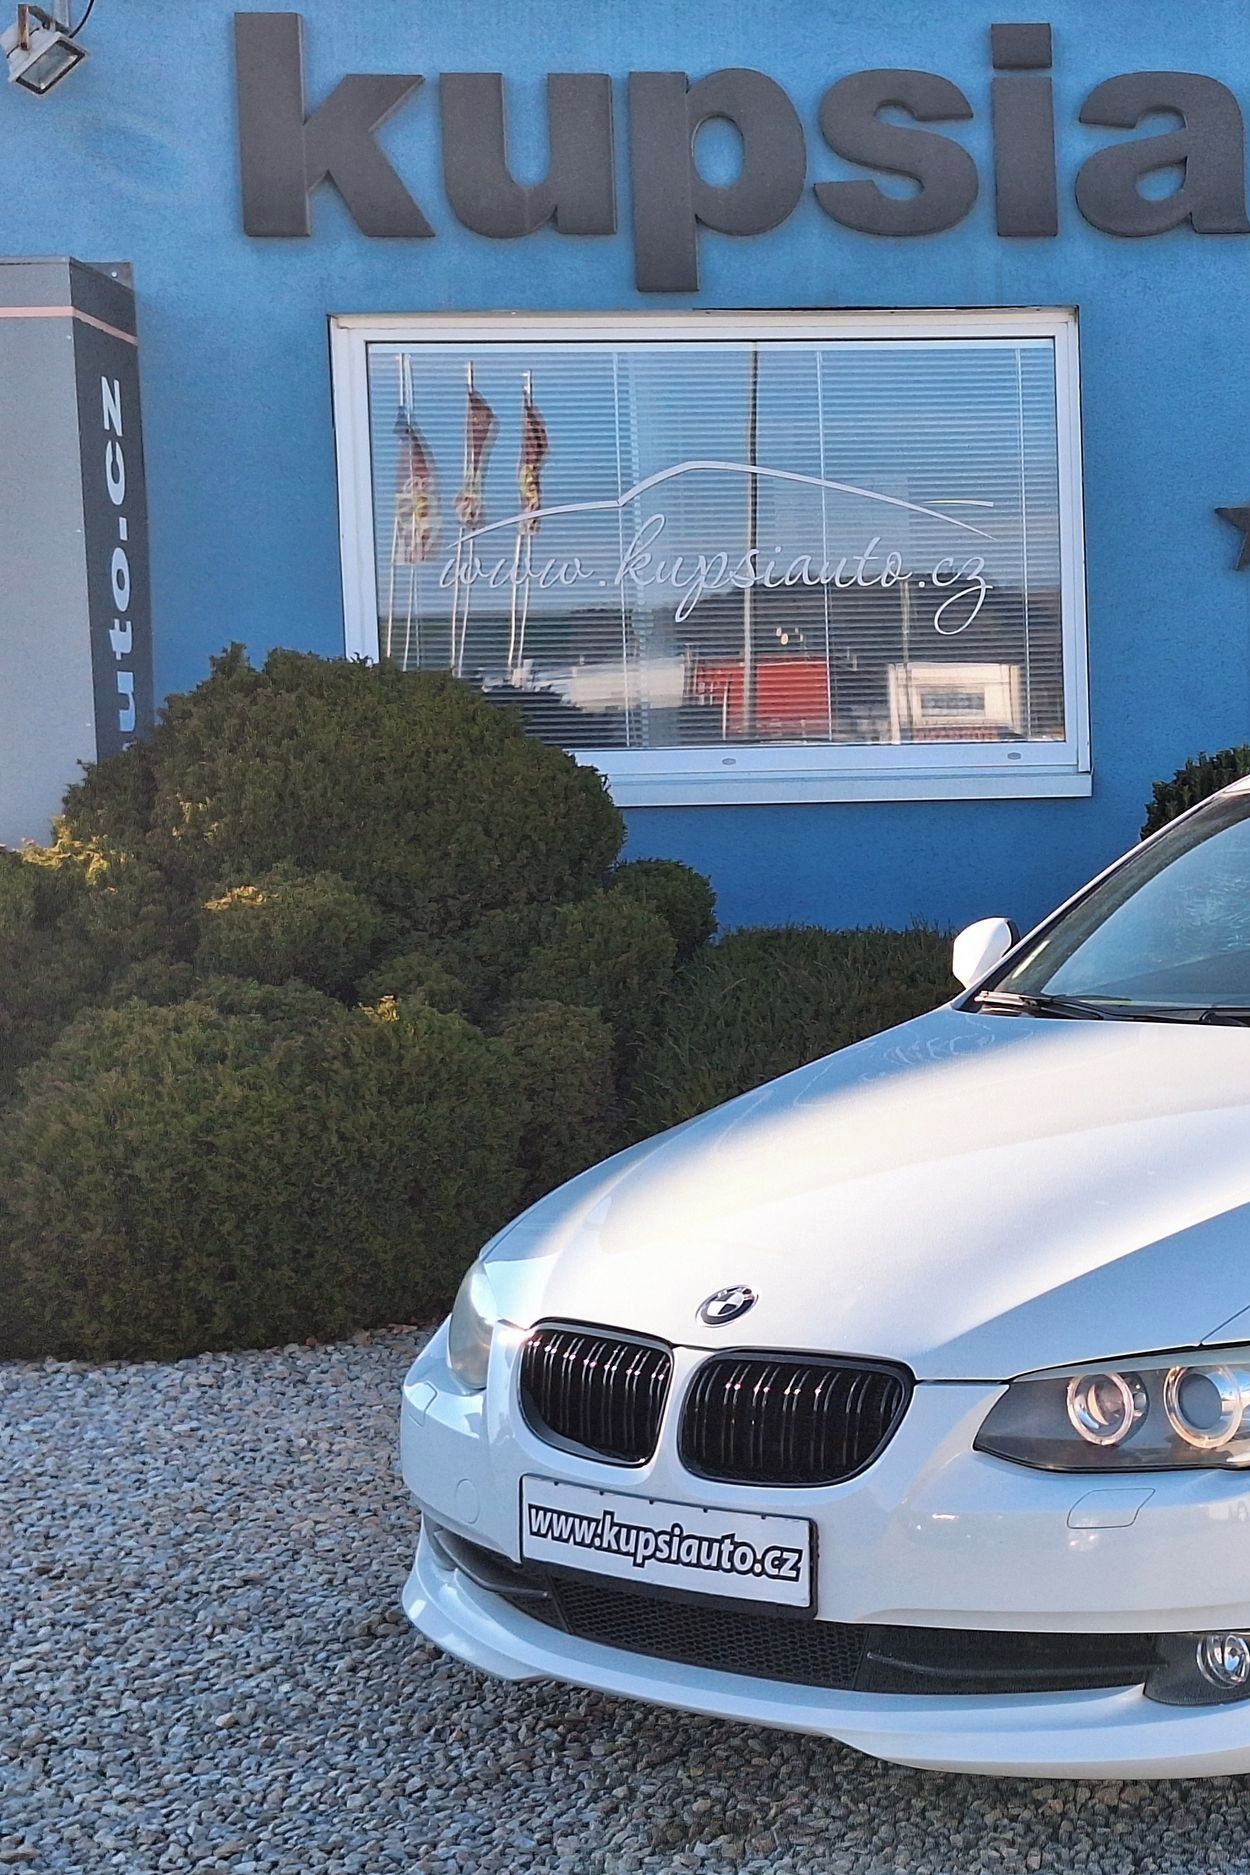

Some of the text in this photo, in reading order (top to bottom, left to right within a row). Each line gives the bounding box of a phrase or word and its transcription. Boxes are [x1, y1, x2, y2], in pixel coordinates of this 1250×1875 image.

[101, 376, 136, 751] uto.cz
[439, 513, 994, 635] www.kupsiauto.cz
[528, 1504, 803, 1581] www.kupsiauto.cz
